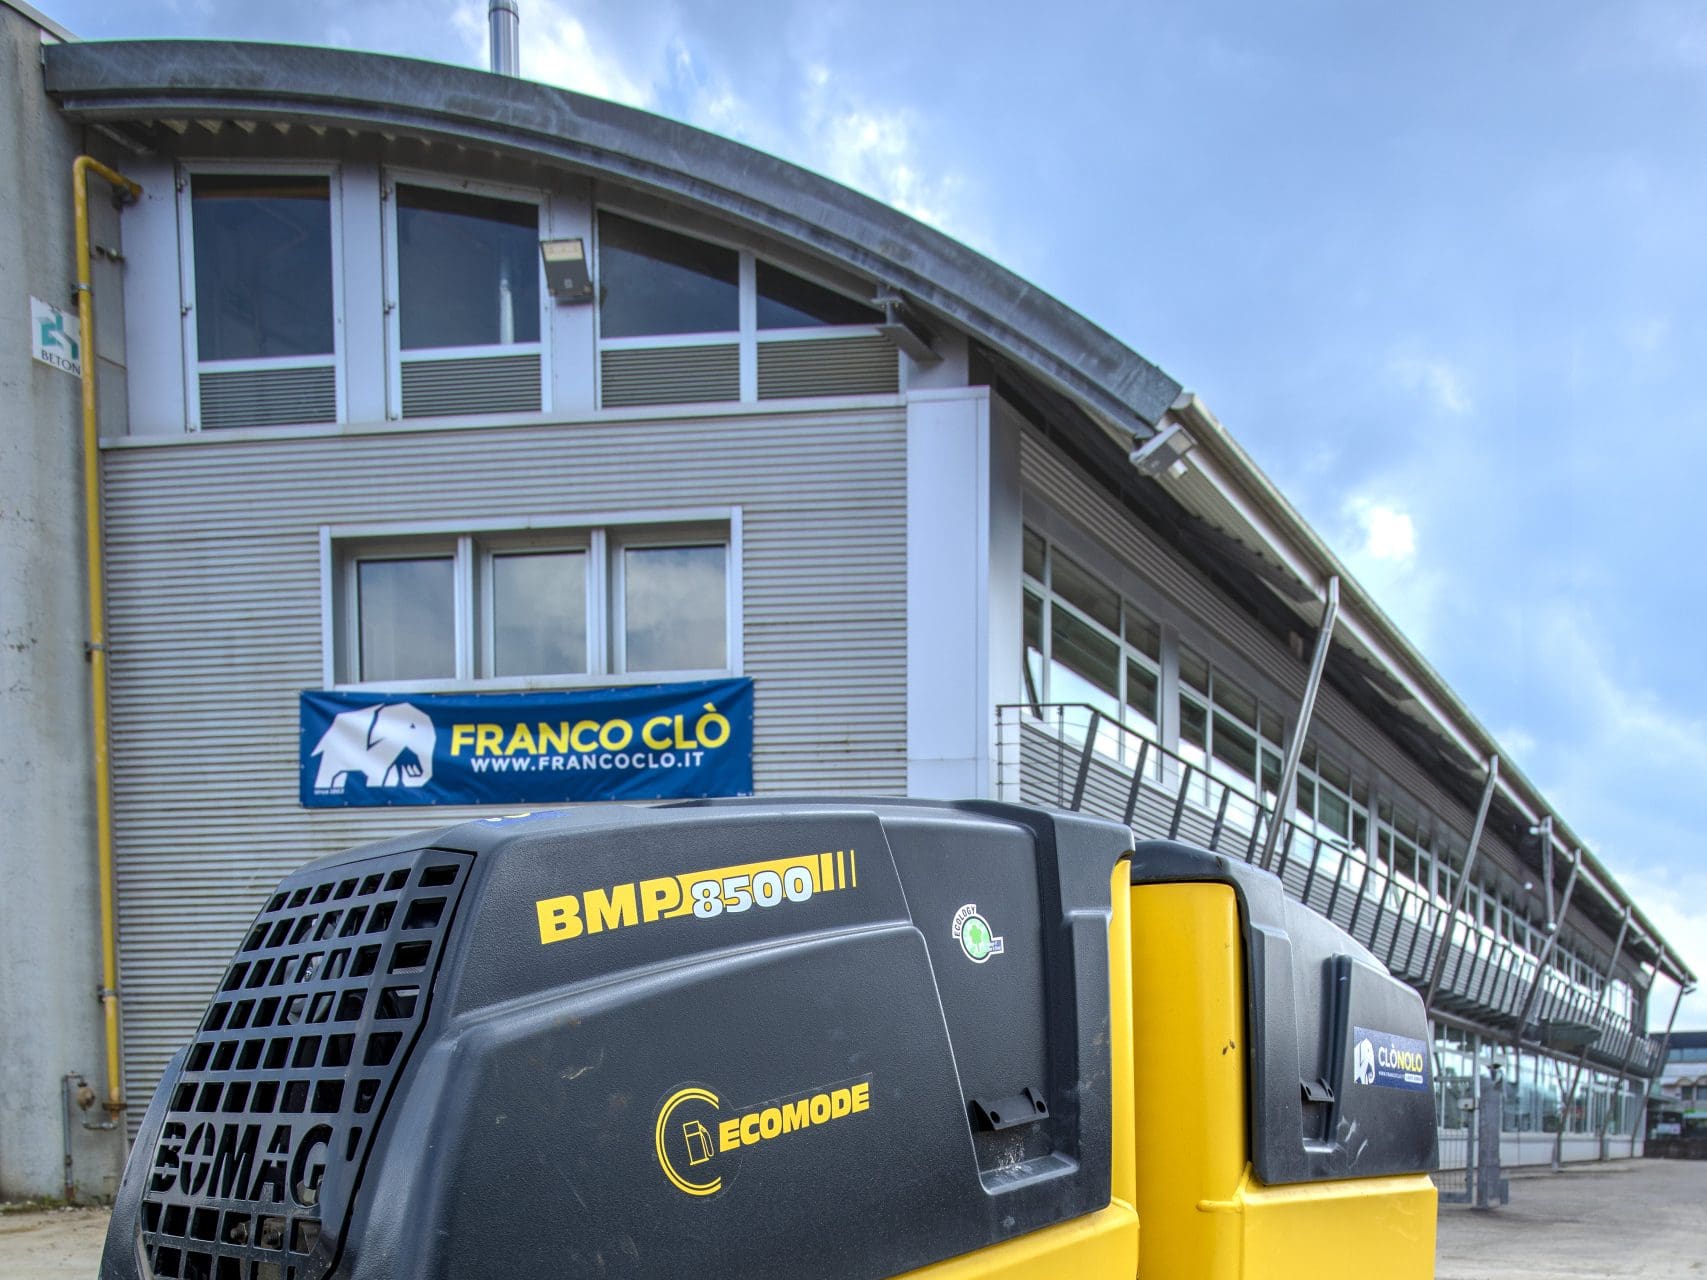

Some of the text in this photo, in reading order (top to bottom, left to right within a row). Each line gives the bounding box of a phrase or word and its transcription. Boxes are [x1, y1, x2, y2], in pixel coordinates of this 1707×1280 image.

[41, 349, 80, 374] BETON
[450, 703, 731, 757] FRANCO CLÒ
[470, 752, 705, 773] WWW.FRANCOCLO.IT
[954, 906, 976, 937] ECOLOGY
[719, 1081, 870, 1153] ECOMODE
[150, 1121, 334, 1209] BOMAG
